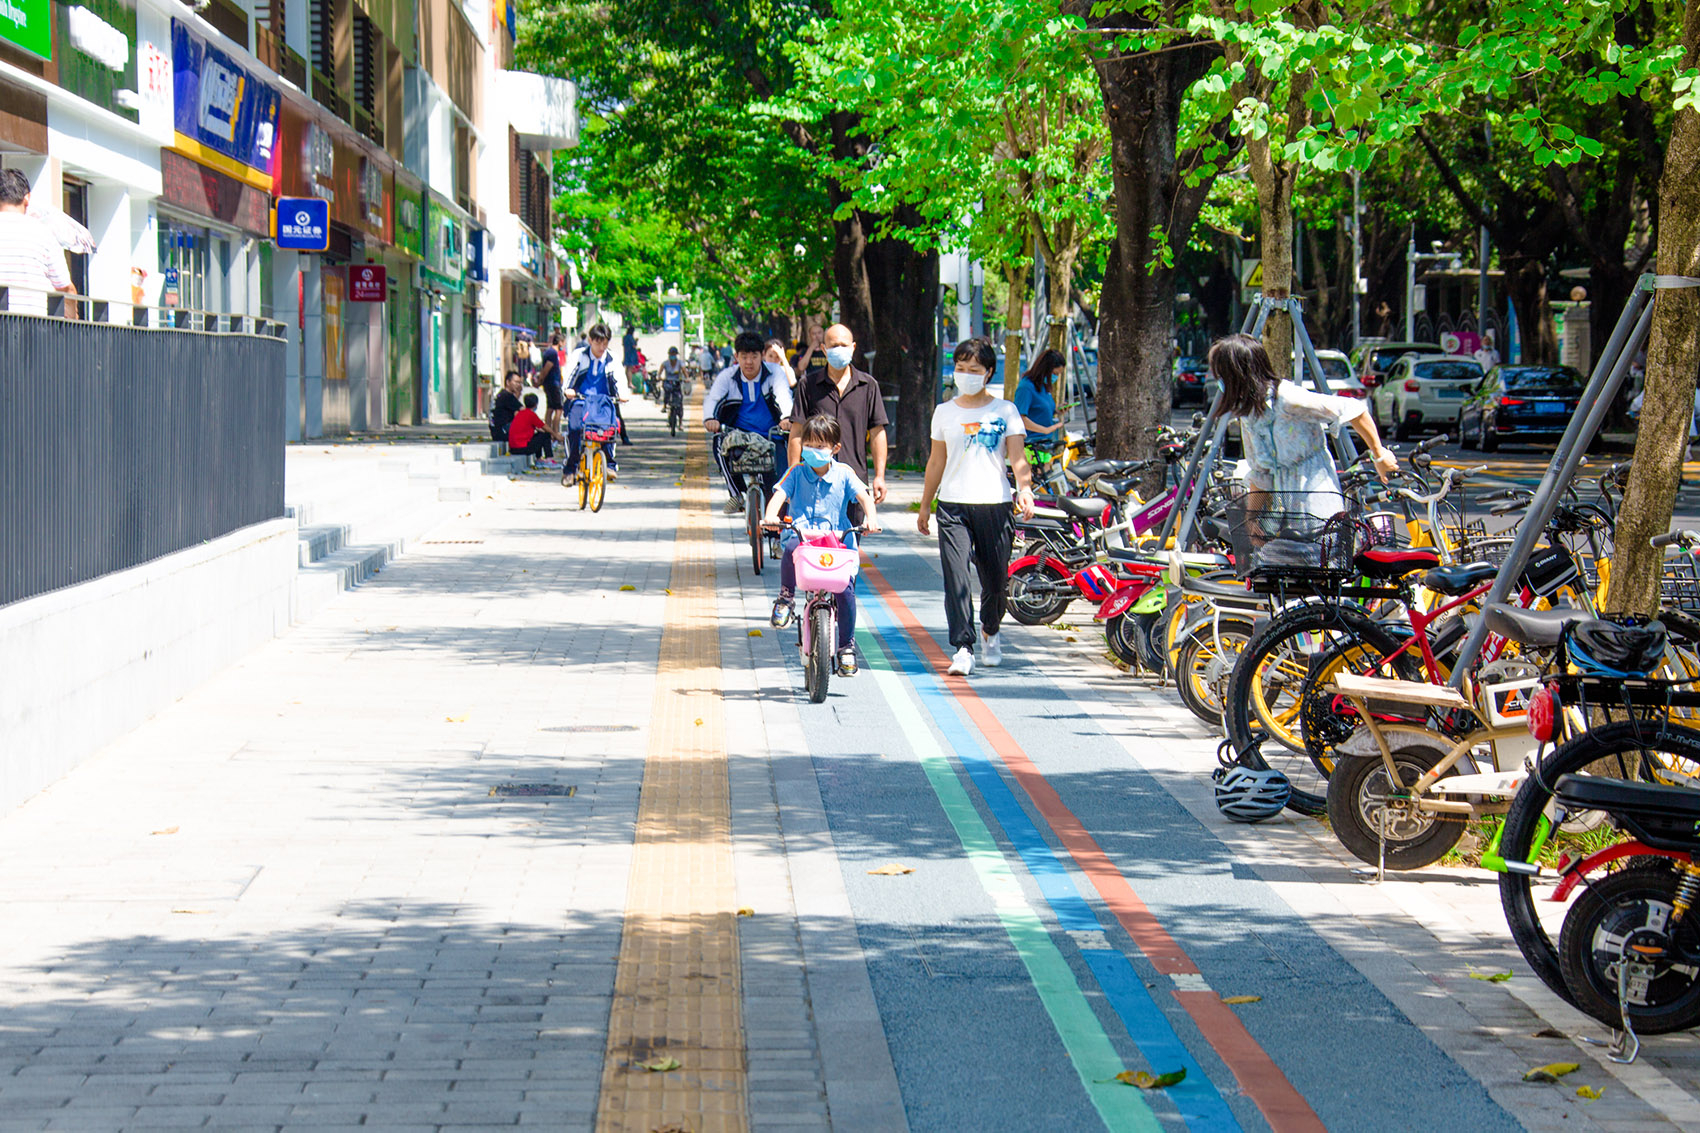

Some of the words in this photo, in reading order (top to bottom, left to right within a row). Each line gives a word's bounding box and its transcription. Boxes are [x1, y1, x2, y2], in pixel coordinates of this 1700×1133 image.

[282, 225, 322, 234] 国元证券
[666, 308, 678, 324] P
